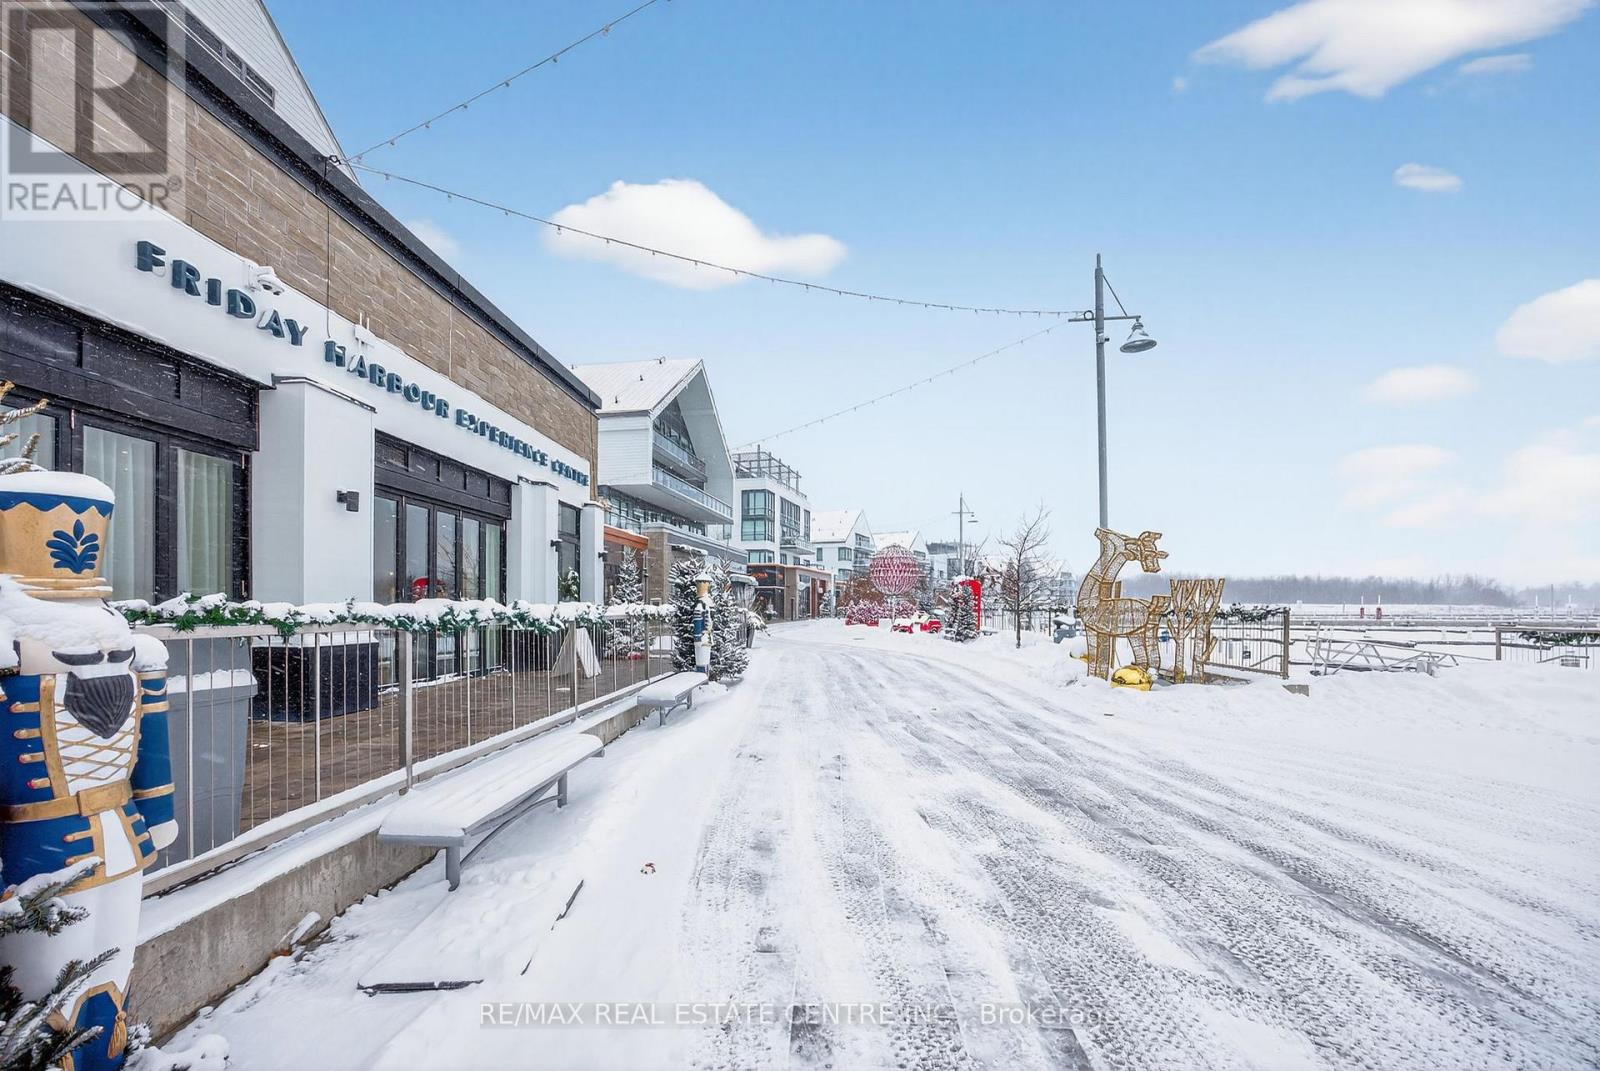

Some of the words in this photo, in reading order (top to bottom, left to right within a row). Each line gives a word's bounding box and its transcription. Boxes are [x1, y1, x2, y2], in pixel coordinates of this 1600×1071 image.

[136, 240, 308, 346] FRIDAY
[324, 340, 449, 418] HARBOUR
[455, 409, 548, 466] EXPERIENCE
[551, 459, 589, 486] CENTRE
